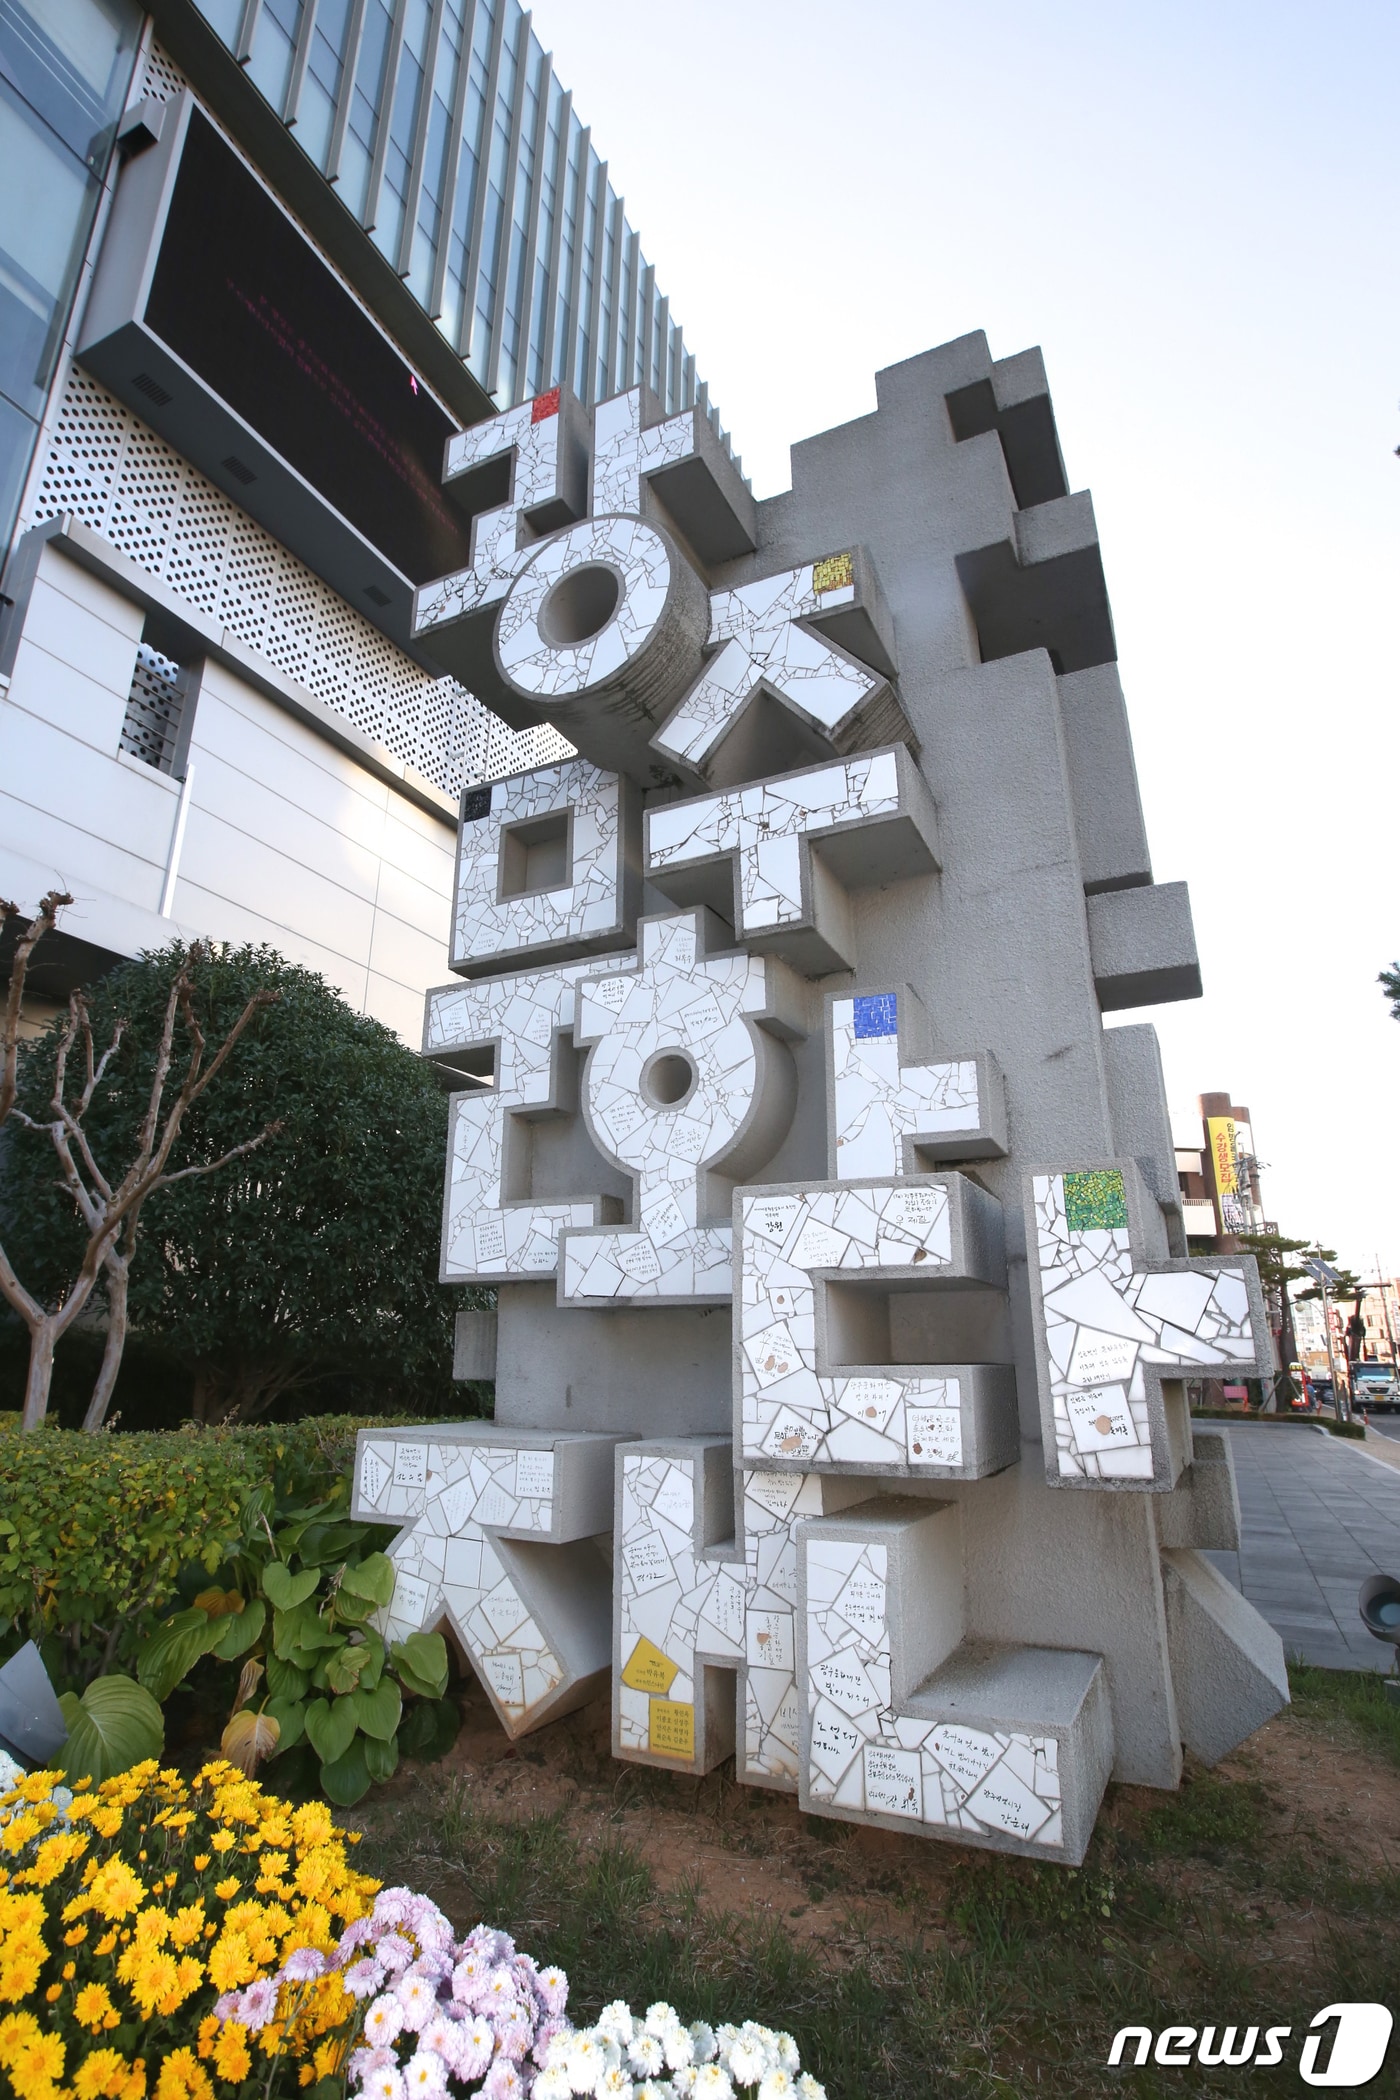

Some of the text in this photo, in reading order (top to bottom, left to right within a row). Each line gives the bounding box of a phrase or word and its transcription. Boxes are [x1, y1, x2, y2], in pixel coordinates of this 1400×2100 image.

[1216, 1132, 1231, 1183] 수강생모집
[820, 1664, 861, 1686] 광주문화재단
[983, 1788, 1022, 1813] 광주광역시장
